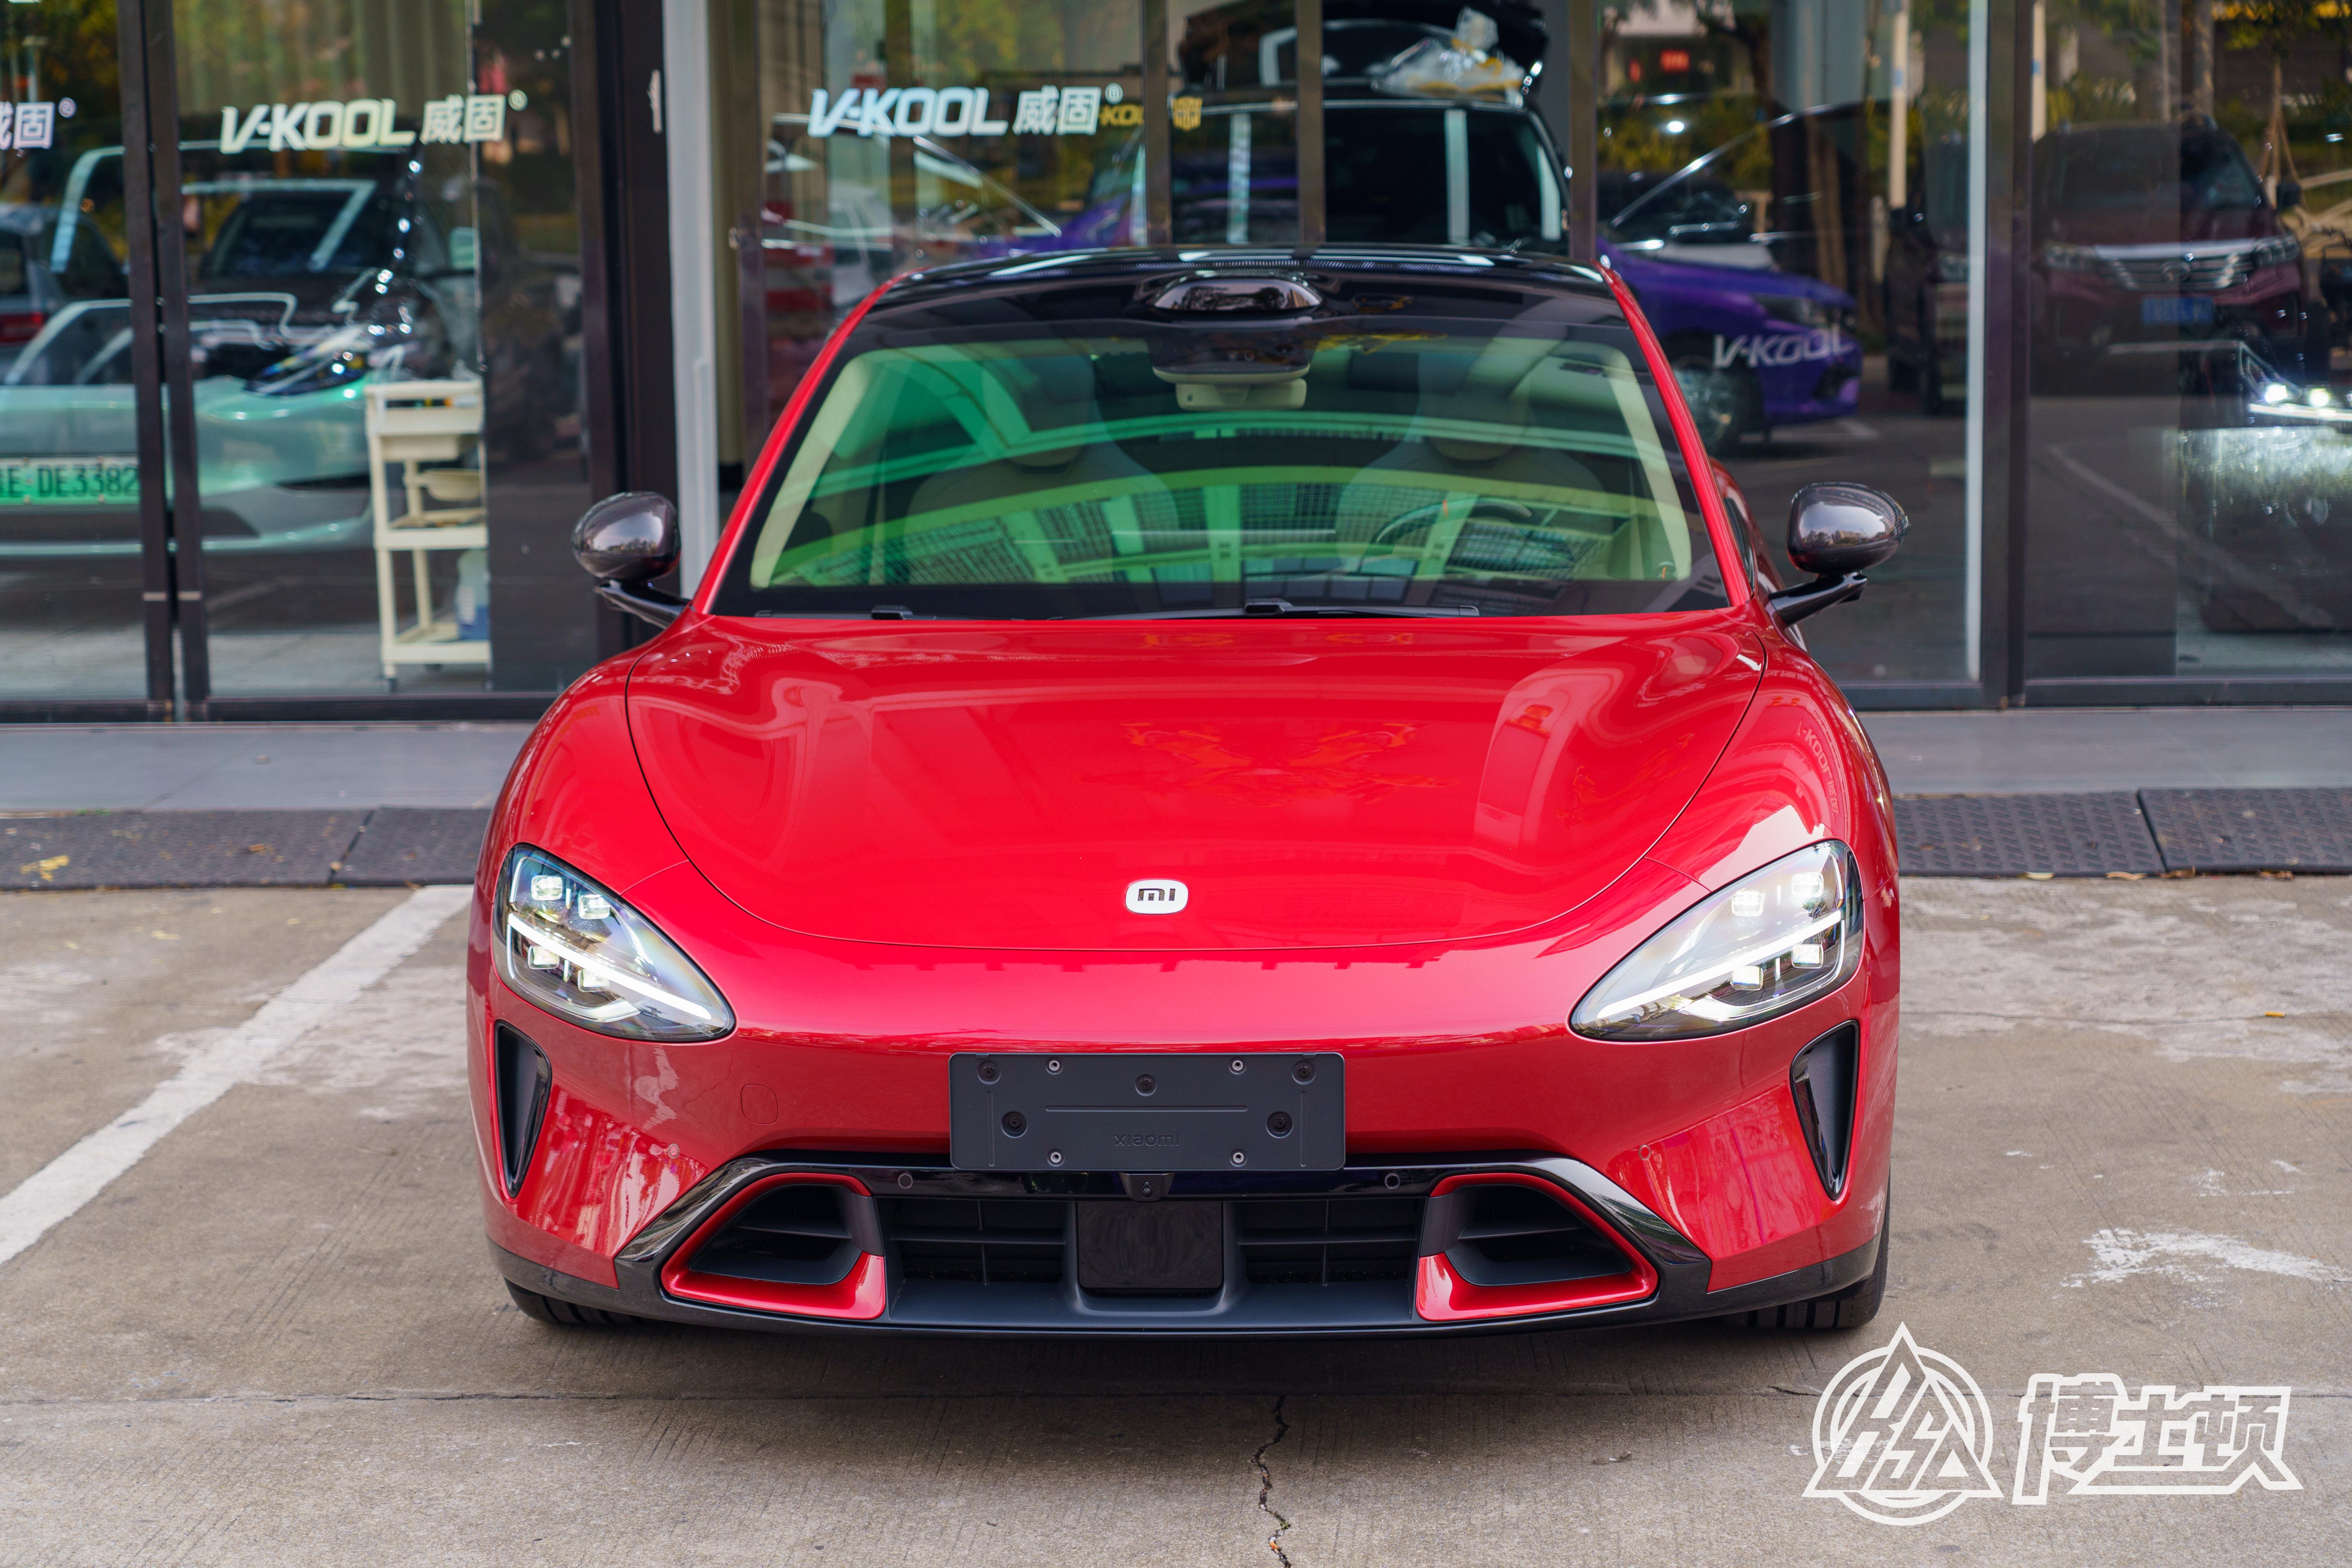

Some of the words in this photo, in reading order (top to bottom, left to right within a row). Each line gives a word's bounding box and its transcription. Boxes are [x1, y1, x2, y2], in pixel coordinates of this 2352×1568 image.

[220, 98, 416, 154] V-KOOL
[419, 94, 506, 145] 威固
[808, 87, 1009, 137] V-KOOL
[1012, 85, 1102, 135] 威固
[1713, 323, 1854, 368] V-KOOL
